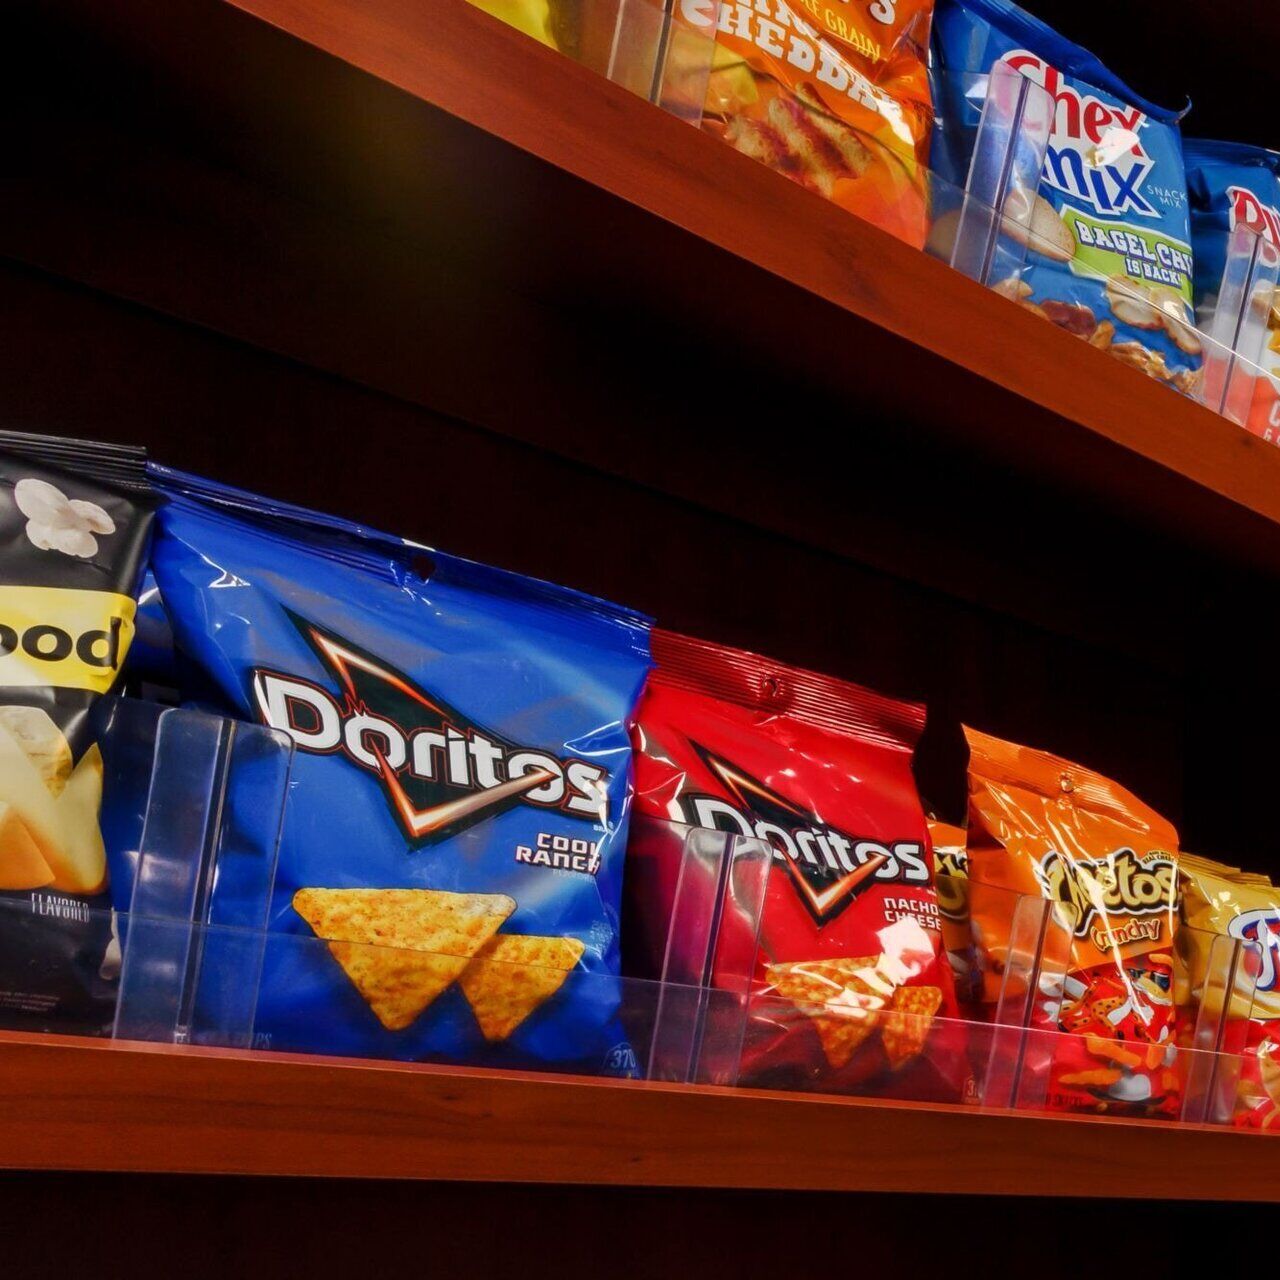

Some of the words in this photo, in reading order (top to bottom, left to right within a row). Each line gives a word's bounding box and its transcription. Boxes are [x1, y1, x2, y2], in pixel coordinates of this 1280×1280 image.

[824, 9, 882, 65] GRAIN
[1000, 53, 1150, 158] Chex
[1146, 184, 1187, 201] SNACK
[1159, 196, 1184, 209] MIX
[1074, 219, 1157, 262] BAGEL
[1155, 241, 1193, 280] CHI
[1125, 258, 1143, 277] IS
[1142, 262, 1184, 290] BACK!
[260, 673, 608, 815] Doritos
[537, 832, 600, 856] COOL
[692, 798, 930, 882] Doritos
[515, 845, 601, 875] RANCH
[883, 897, 939, 917] NACHO
[884, 910, 942, 932] CHESE
